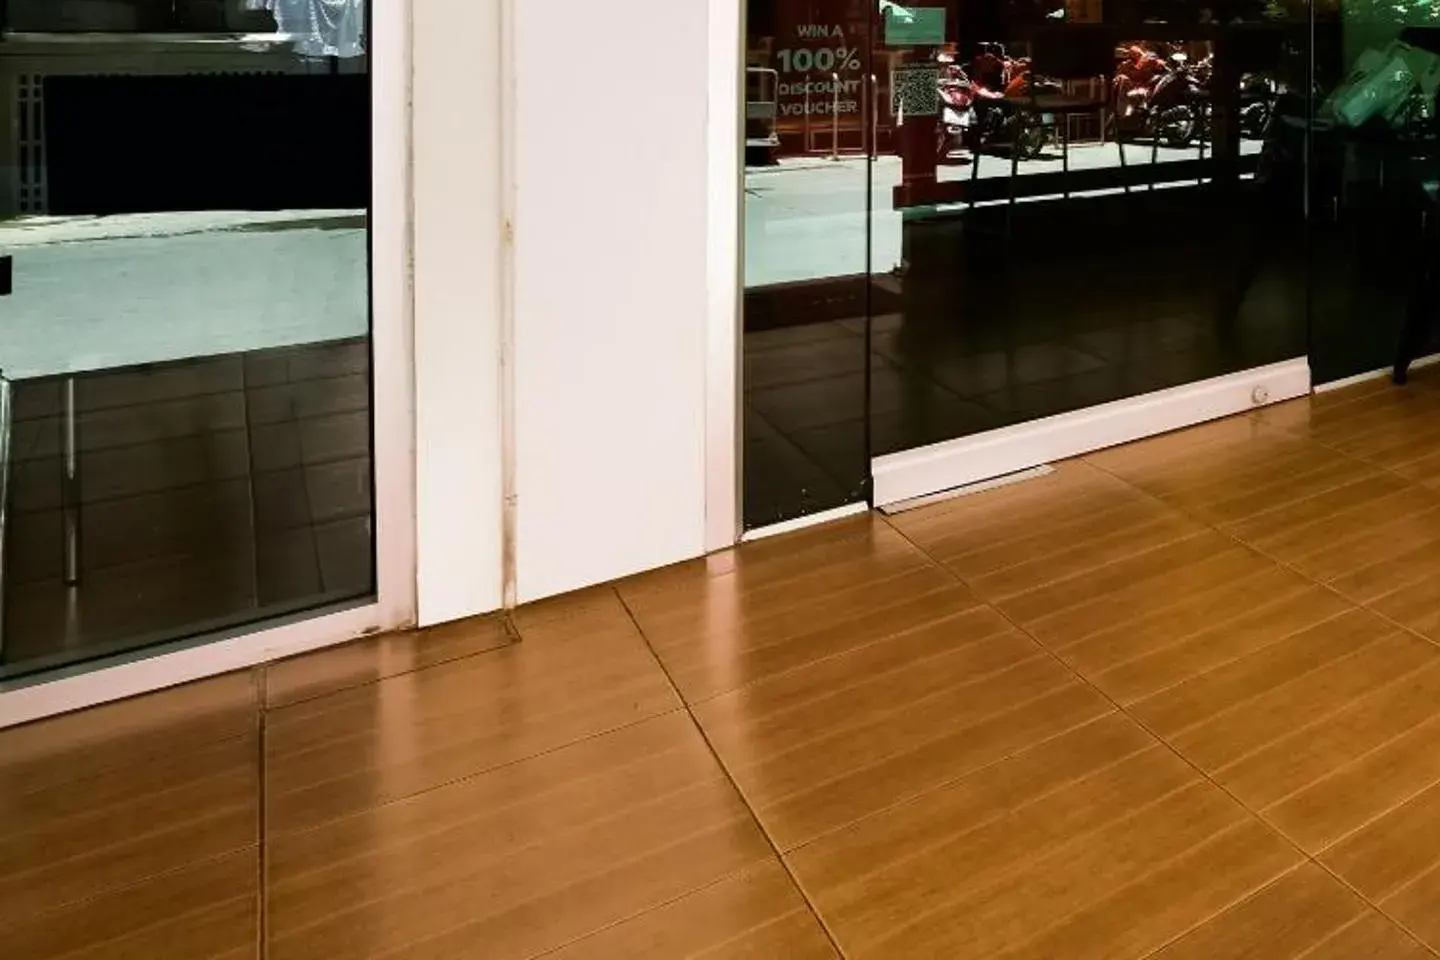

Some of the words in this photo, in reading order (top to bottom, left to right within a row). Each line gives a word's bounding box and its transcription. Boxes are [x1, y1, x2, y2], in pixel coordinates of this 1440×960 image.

[798, 24, 829, 37] WIN
[831, 24, 844, 37] A
[777, 47, 861, 73] 100%
[778, 80, 861, 96] DISCOUNT
[780, 100, 858, 115] VOUCHER
